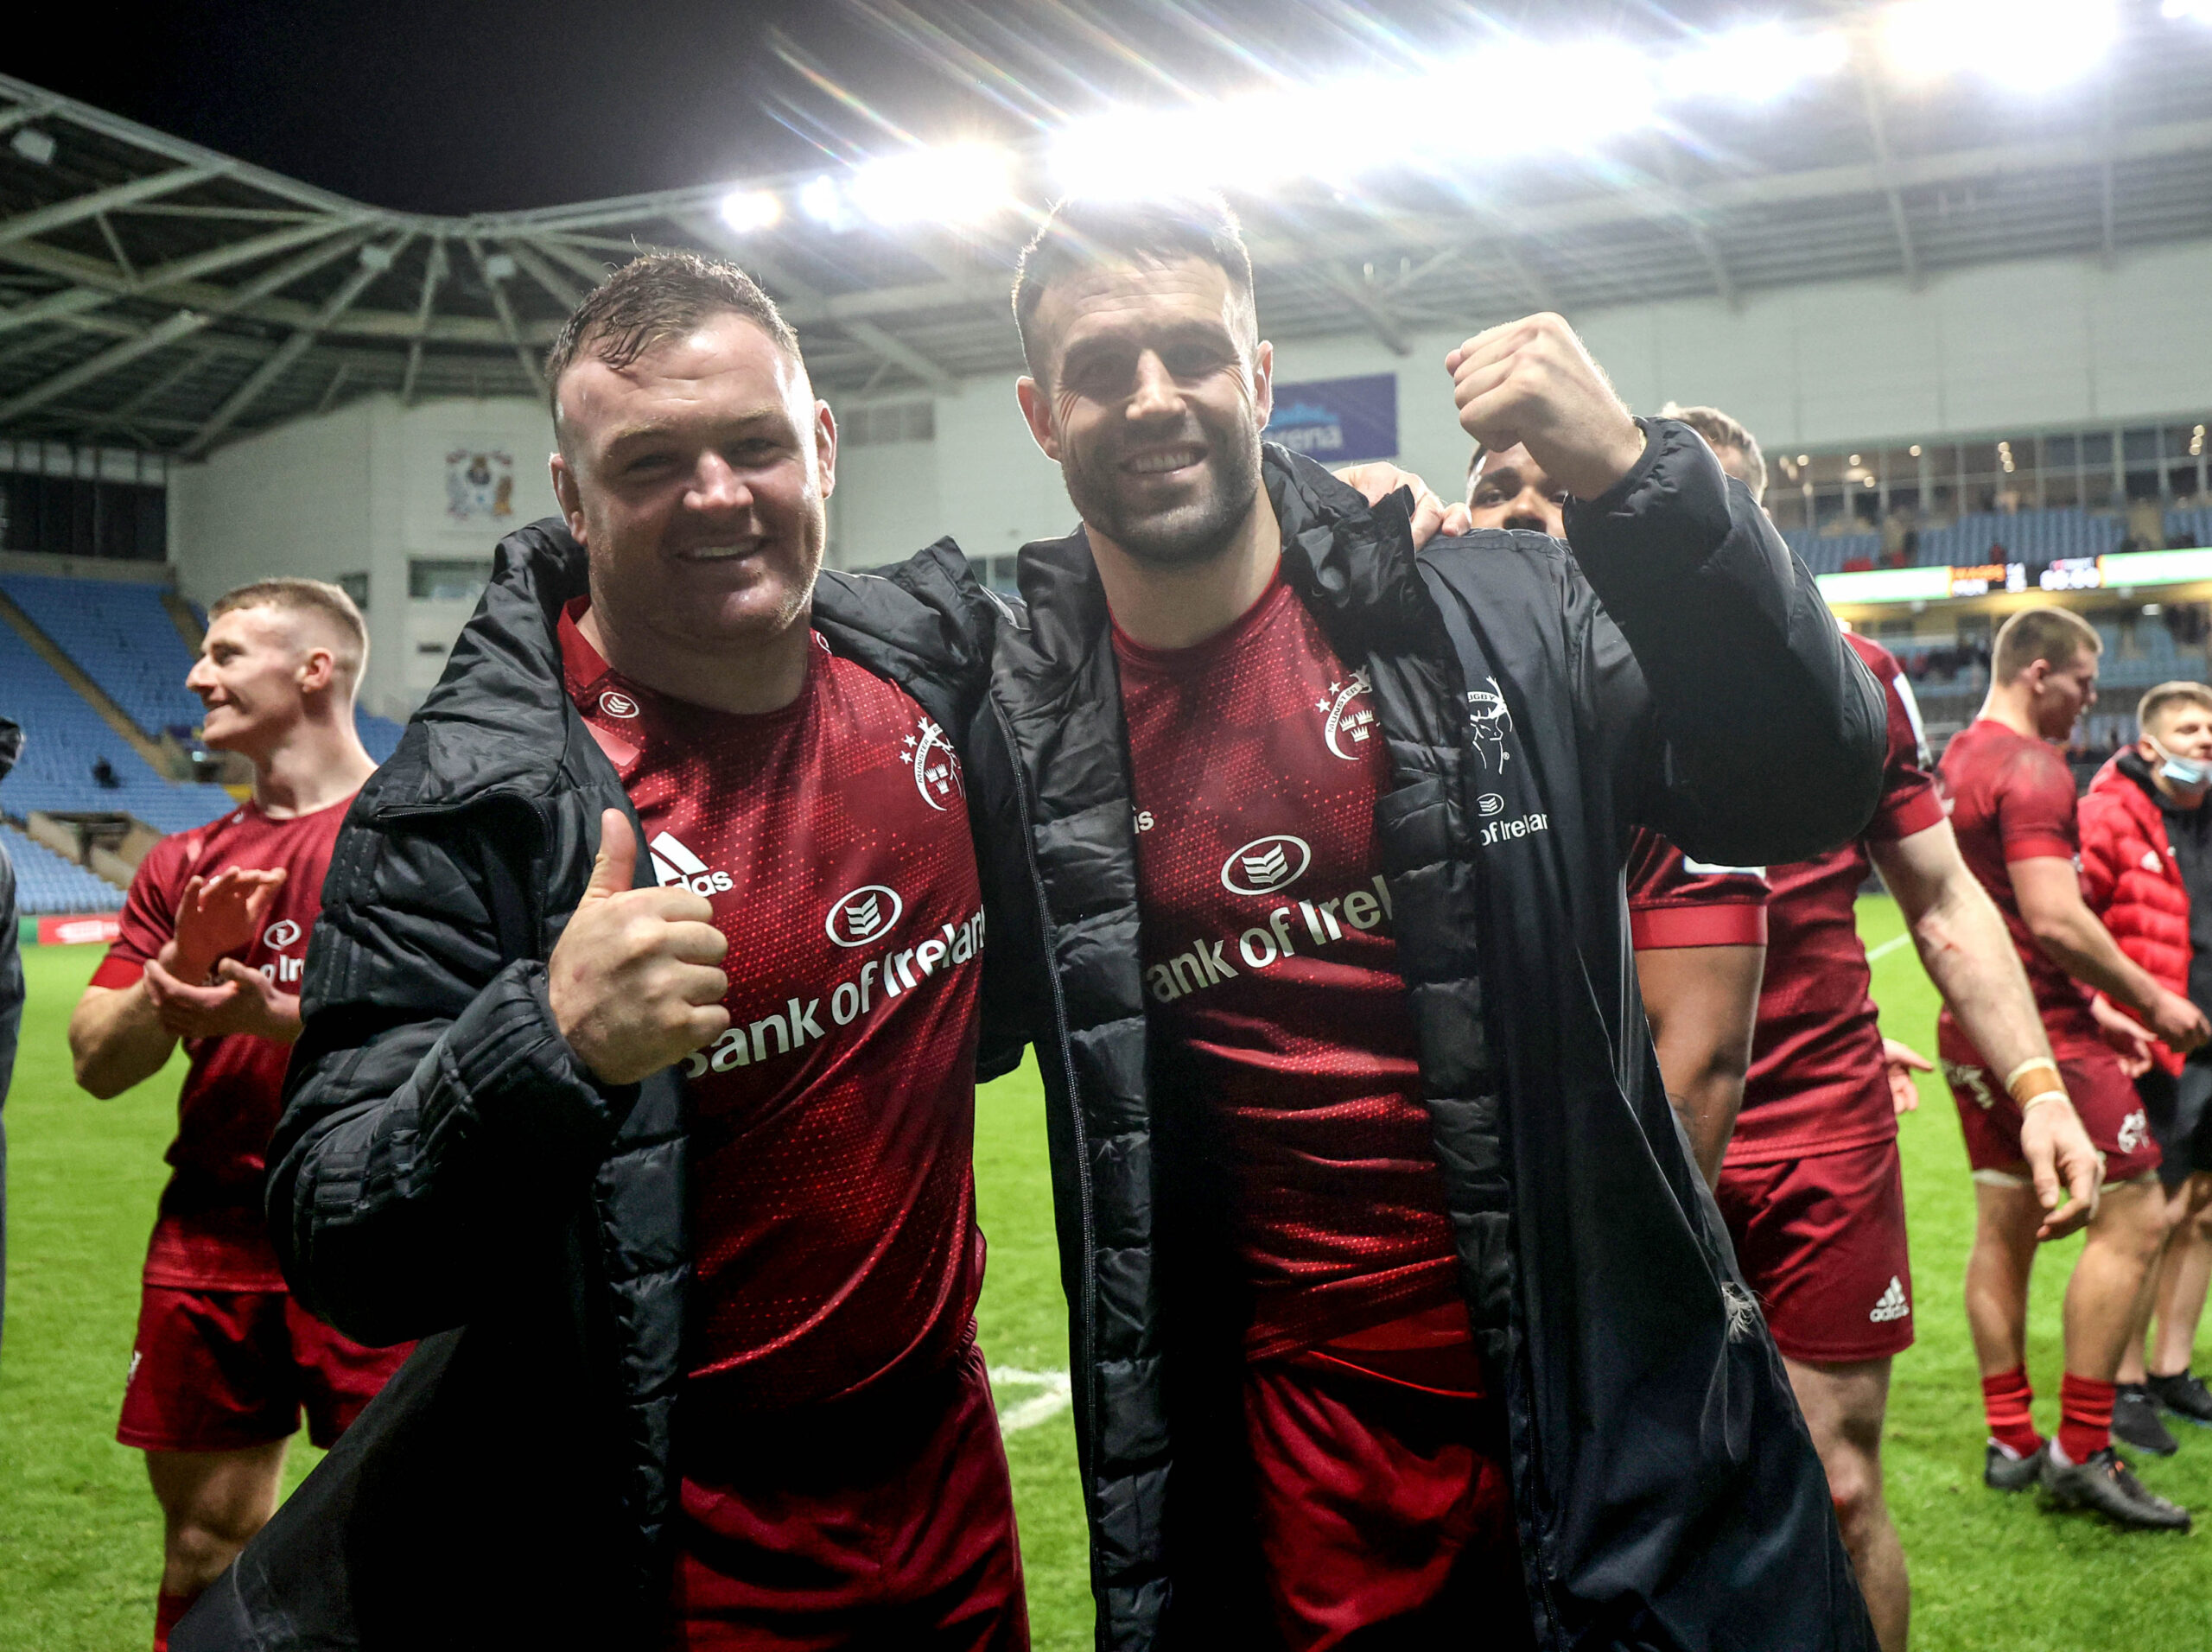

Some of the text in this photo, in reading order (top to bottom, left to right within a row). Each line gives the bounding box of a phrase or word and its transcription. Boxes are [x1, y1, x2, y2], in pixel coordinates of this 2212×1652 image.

[1328, 686, 1359, 734] MUNSTER
[918, 738, 930, 784] MUNSTER
[1146, 874, 1393, 1004] ank of Irel
[831, 960, 879, 1026] of
